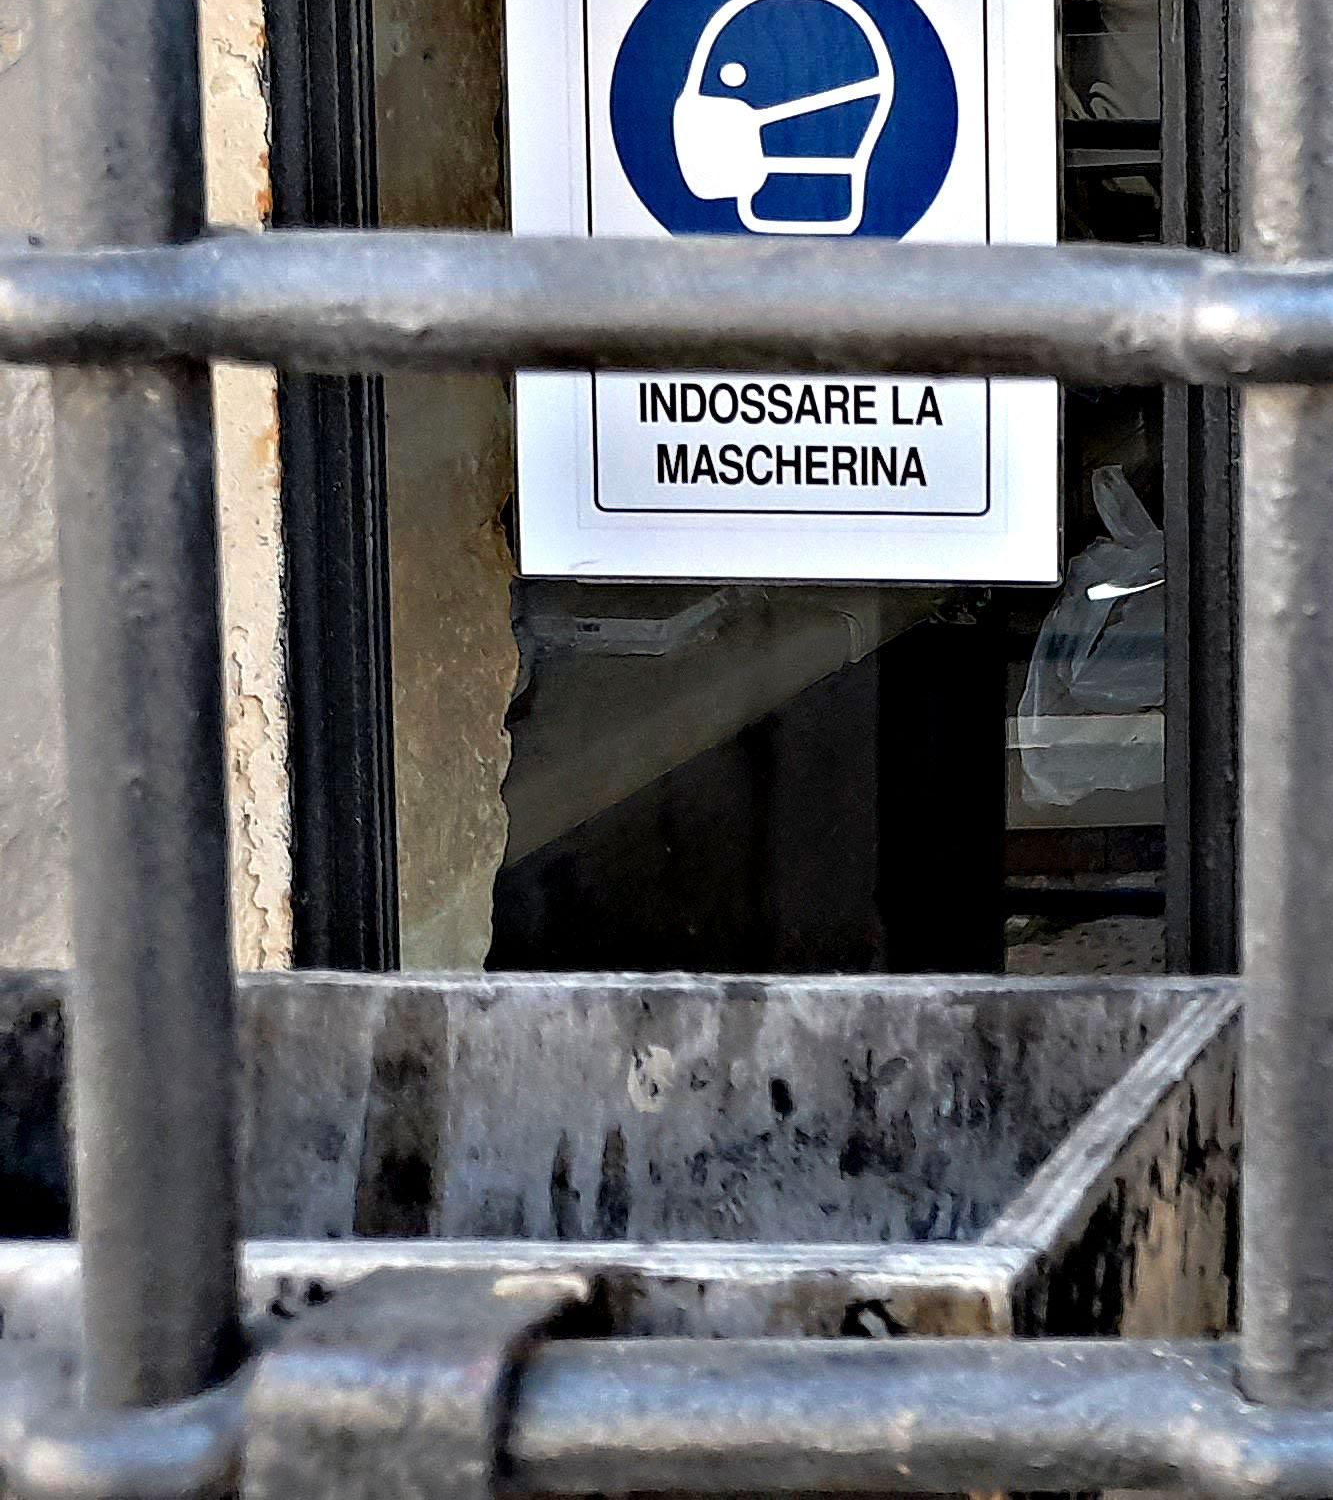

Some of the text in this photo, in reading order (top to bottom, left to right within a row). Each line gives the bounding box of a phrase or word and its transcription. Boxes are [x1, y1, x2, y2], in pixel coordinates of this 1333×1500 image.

[640, 382, 943, 426] INDOSSARE LA
[657, 443, 927, 487] MASCHERINA
